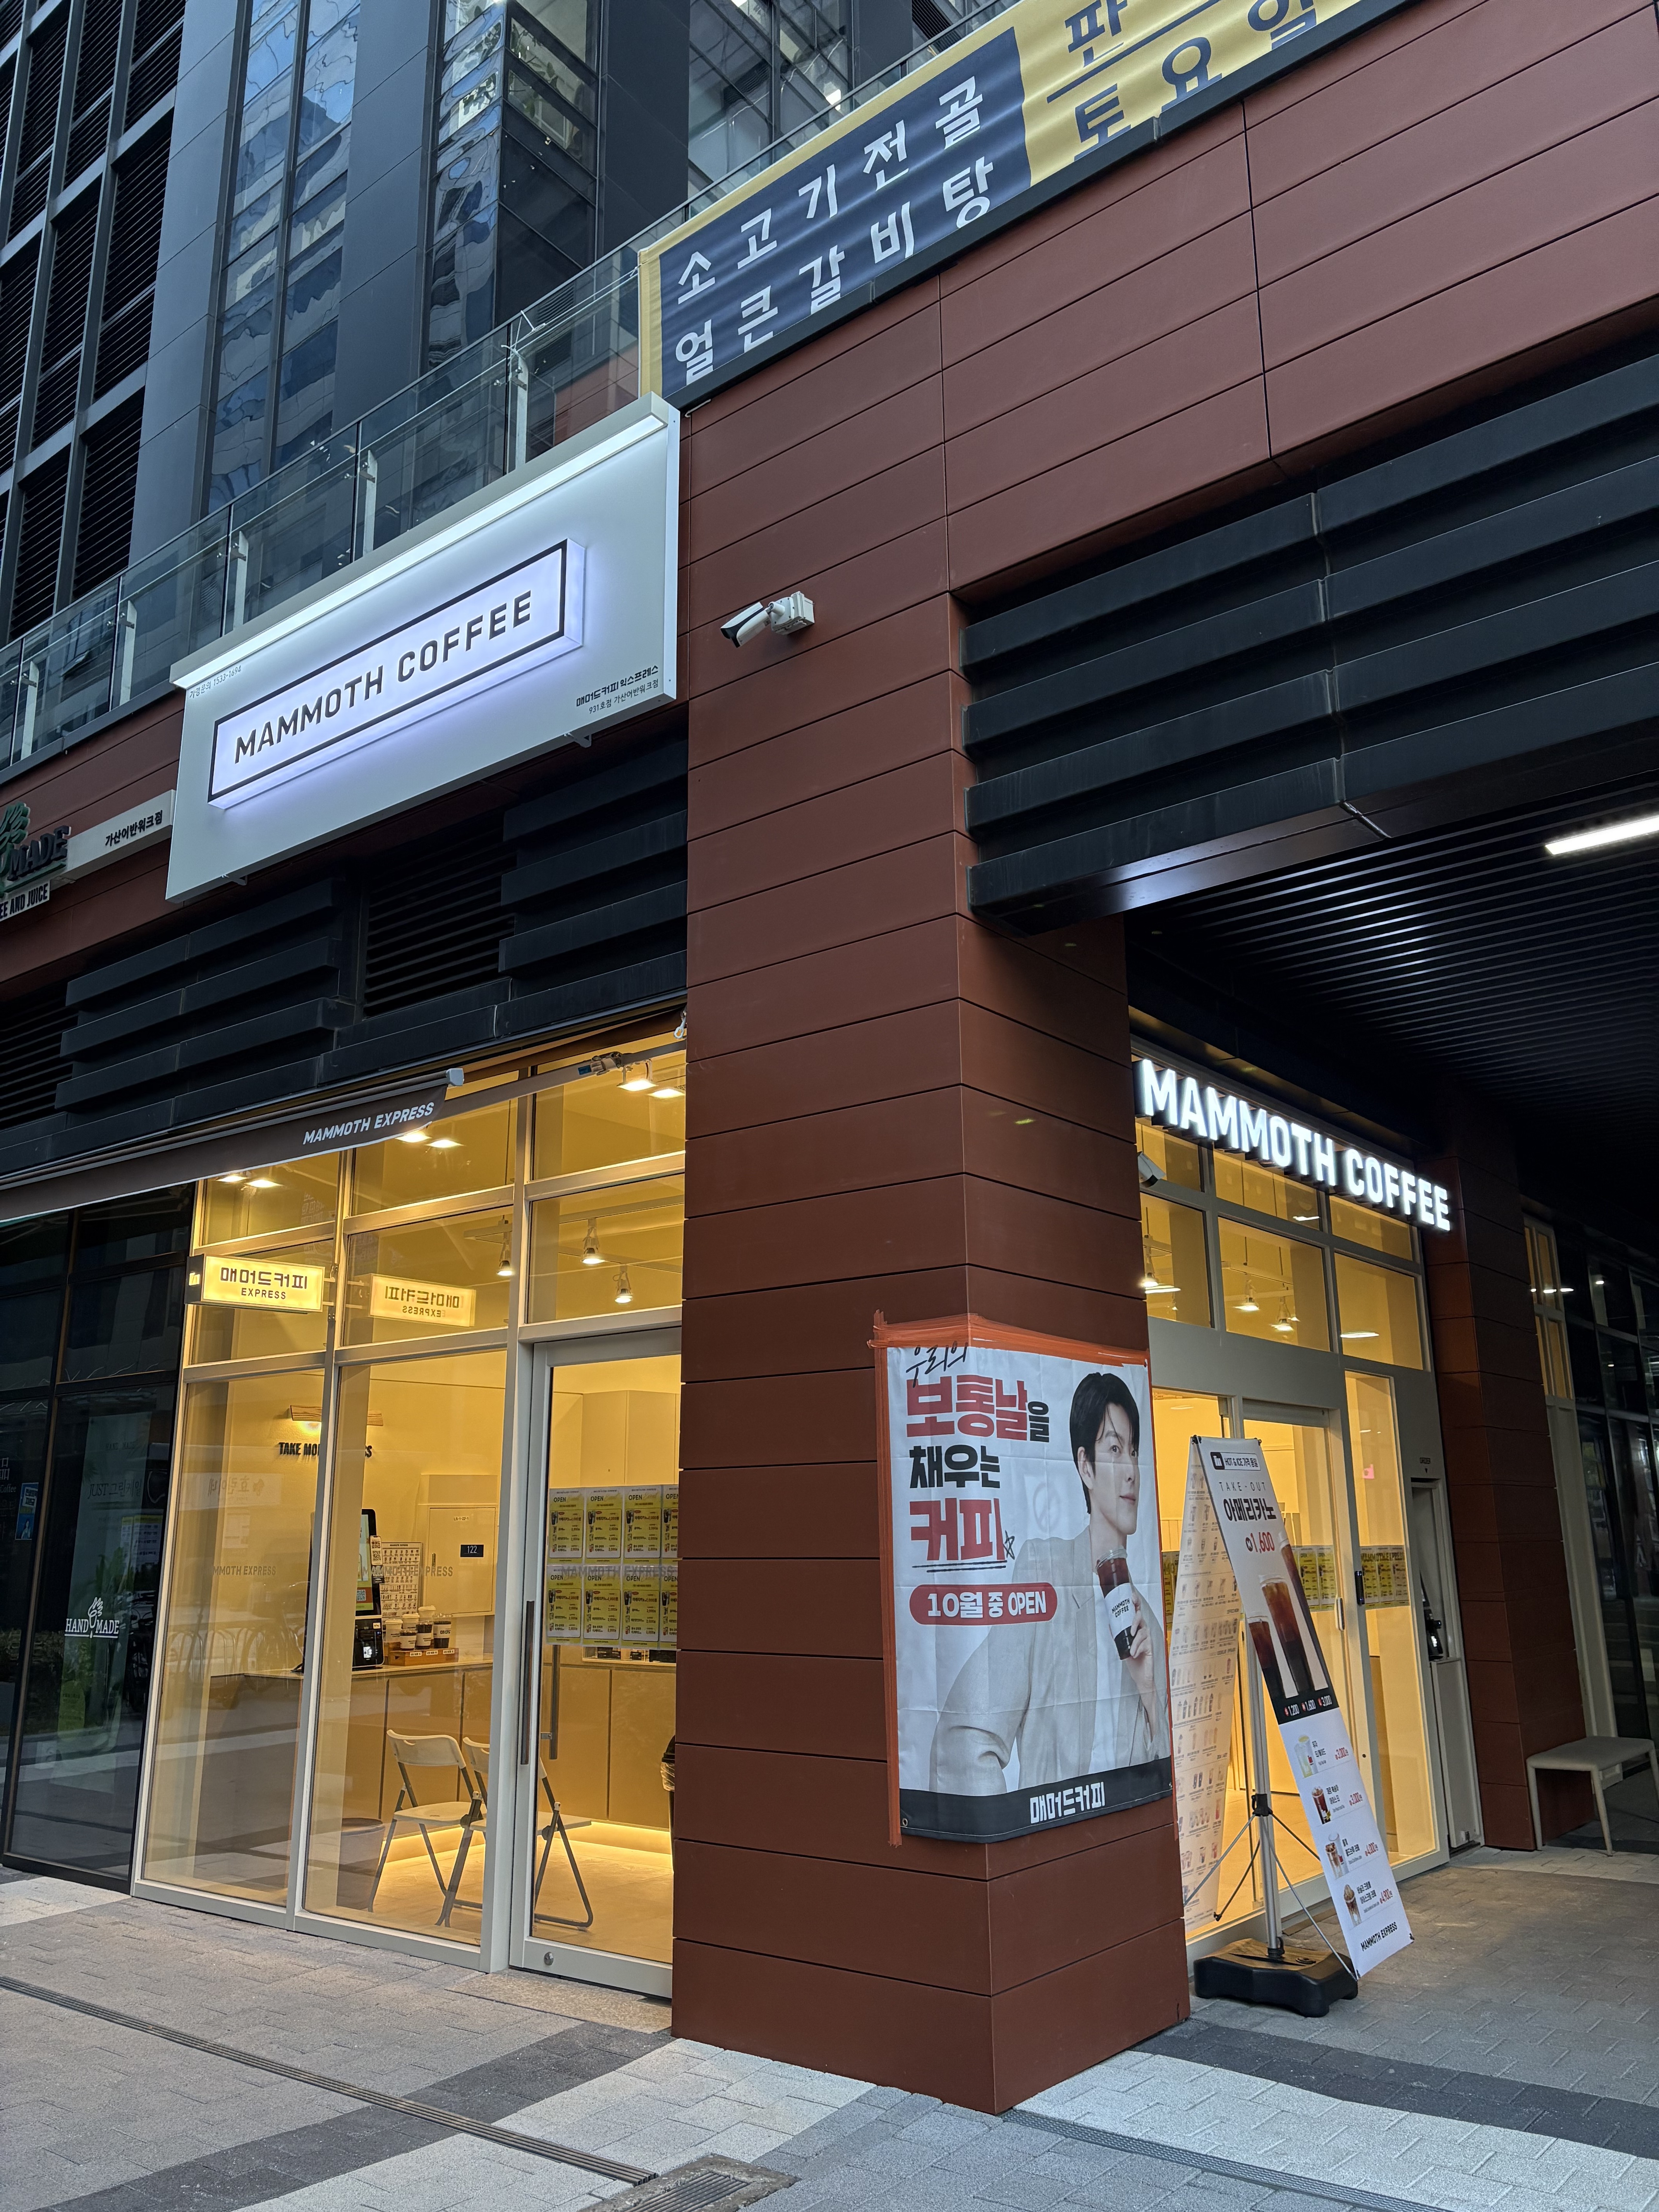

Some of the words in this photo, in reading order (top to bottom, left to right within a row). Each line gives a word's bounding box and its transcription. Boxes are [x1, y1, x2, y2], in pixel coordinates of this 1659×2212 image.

[678, 76, 984, 304] 소고기전골
[675, 156, 994, 386] 얼큰갈비탕
[213, 665, 241, 686] 1533-1694
[234, 664, 384, 764] MAMMOTH
[397, 590, 532, 683] COFFEE
[576, 681, 619, 707] 매머드커피
[620, 665, 659, 687] 익스프레스
[589, 698, 612, 714] 931호점
[613, 678, 659, 704] 가산어반워크점
[7, 825, 71, 881] MADE
[10, 893, 25, 915] AND
[27, 883, 48, 907] JUICE
[302, 1116, 371, 1145] MAMMOTH
[374, 1101, 435, 1130] EXPRESS
[1142, 1058, 1337, 1187] MAMMOTH
[1345, 1148, 1451, 1232] COFFEE
[220, 1267, 307, 1289] 매머드커피
[241, 1288, 287, 1300] EXPRESS
[906, 1374, 1050, 1443] 보통날을
[278, 1442, 302, 1455] TAKE
[1224, 1457, 1233, 1466] HOT
[1233, 1458, 1237, 1466] &
[1242, 1458, 1251, 1467] 가격
[1250, 1458, 1259, 1468] 동일
[909, 1444, 1001, 1489] 채우는
[87, 1483, 109, 1499] JUST
[1223, 1498, 1277, 1522] 아메리카노
[909, 1497, 1006, 1561] 커피
[1250, 1531, 1275, 1554] 1,600
[467, 1545, 477, 1554] 122
[213, 1565, 241, 1575] MMOTH
[243, 1565, 276, 1576] EXPRESS
[561, 1565, 621, 1577] MAMMOTH
[625, 1565, 673, 1577] EXPRESS
[927, 1592, 984, 1619] 10월
[988, 1591, 1004, 1619] 중
[1008, 1590, 1047, 1616] OPEN
[1111, 1598, 1131, 1614] MAMMOTH
[1115, 1605, 1130, 1618] COFFEE
[65, 1618, 88, 1633] HAND
[94, 1620, 120, 1635] MADE
[1030, 1781, 1106, 1824] 매머드커피
[1360, 1931, 1382, 1952] MAMMOTH
[1380, 1921, 1398, 1939] EXPRESS
